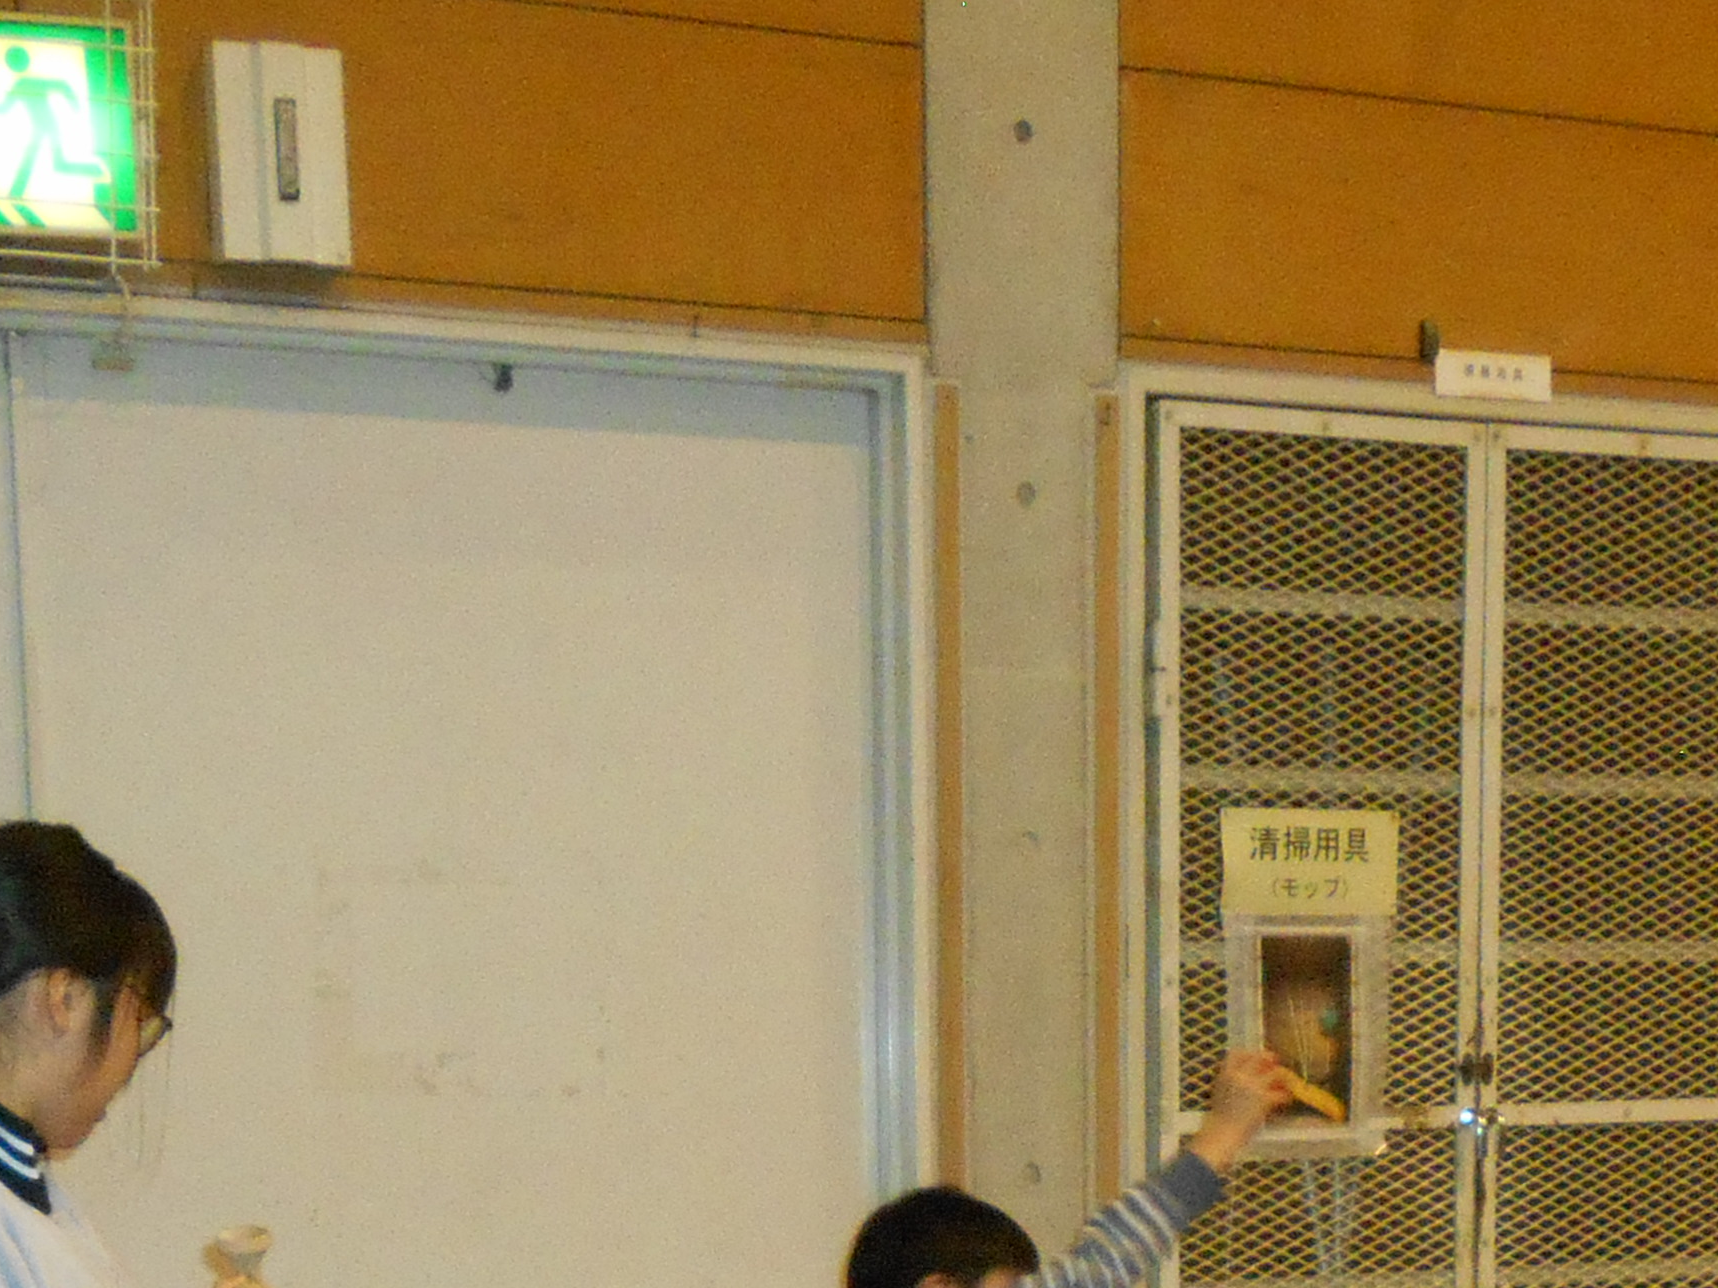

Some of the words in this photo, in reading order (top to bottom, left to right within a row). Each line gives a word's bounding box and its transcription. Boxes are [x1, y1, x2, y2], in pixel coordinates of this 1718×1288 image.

[1250, 825, 1369, 863] 清掃用具
[1271, 876, 1350, 900] （モップ）
